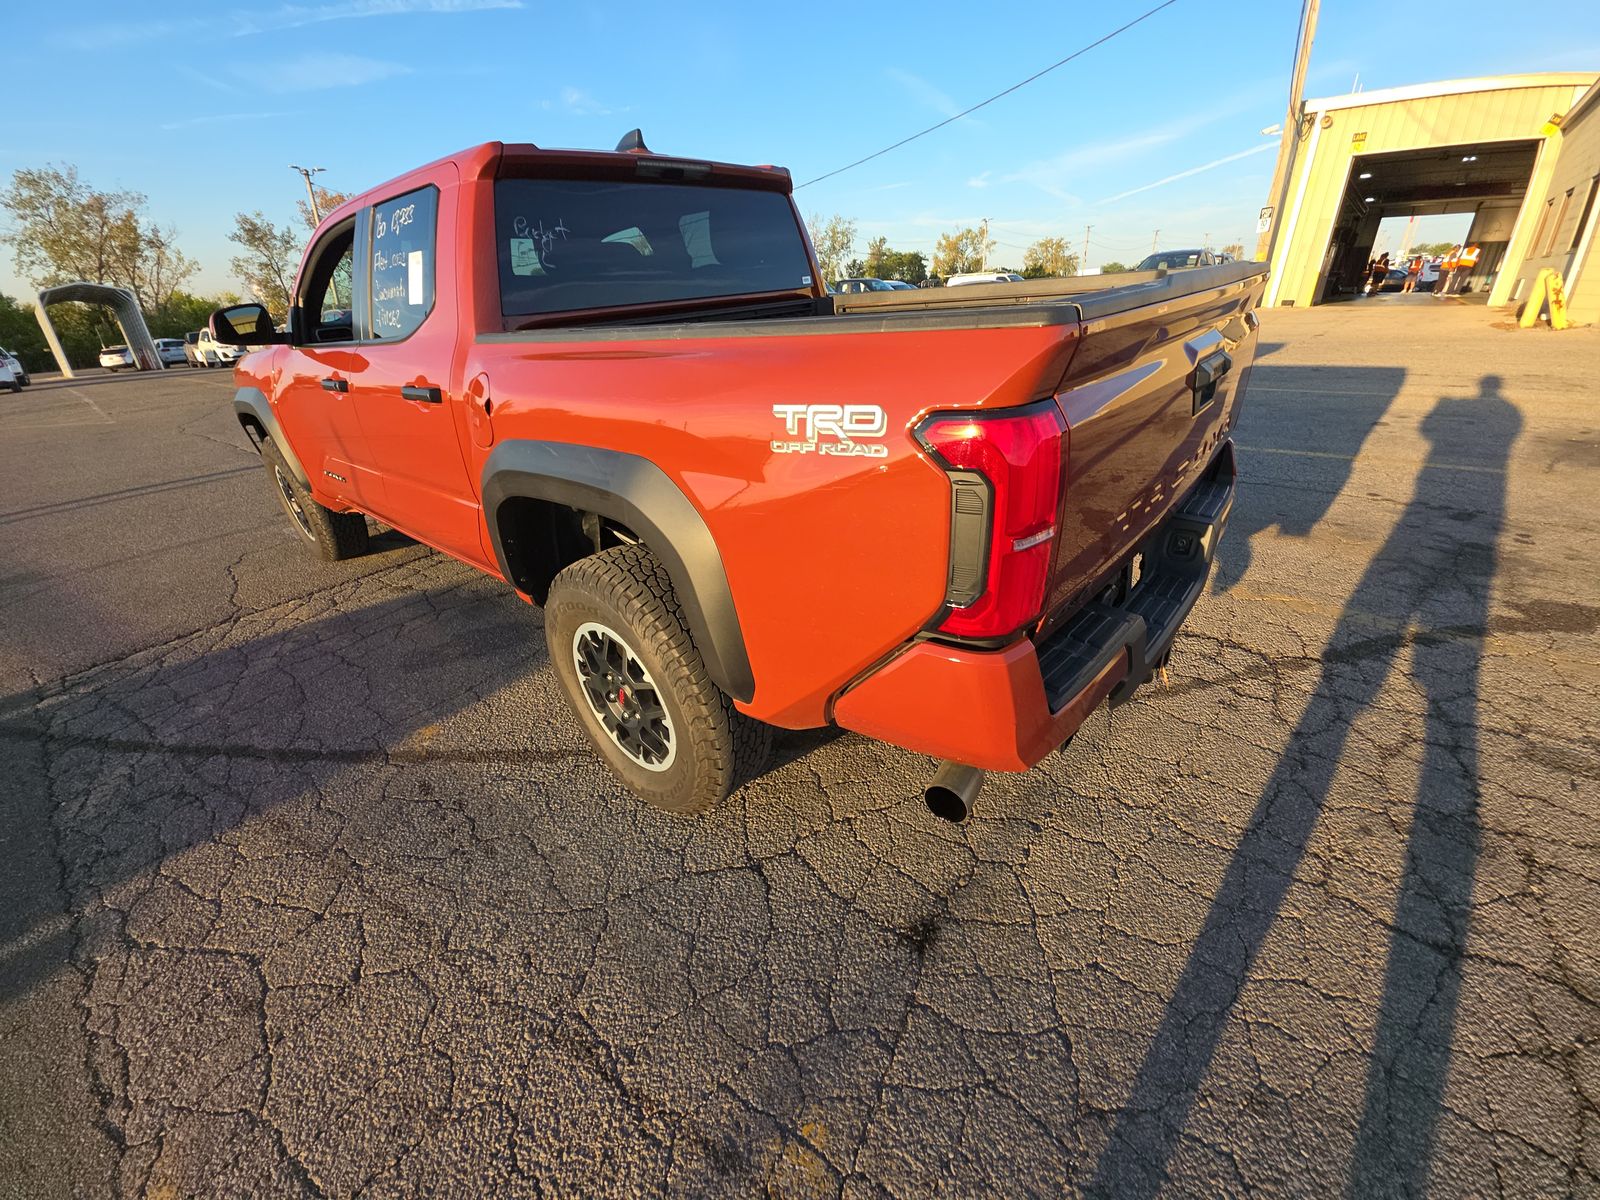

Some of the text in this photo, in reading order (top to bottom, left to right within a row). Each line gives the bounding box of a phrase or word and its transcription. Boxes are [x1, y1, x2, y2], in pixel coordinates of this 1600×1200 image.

[772, 404, 888, 444] TRD
[770, 440, 889, 458] OFF ROAD
